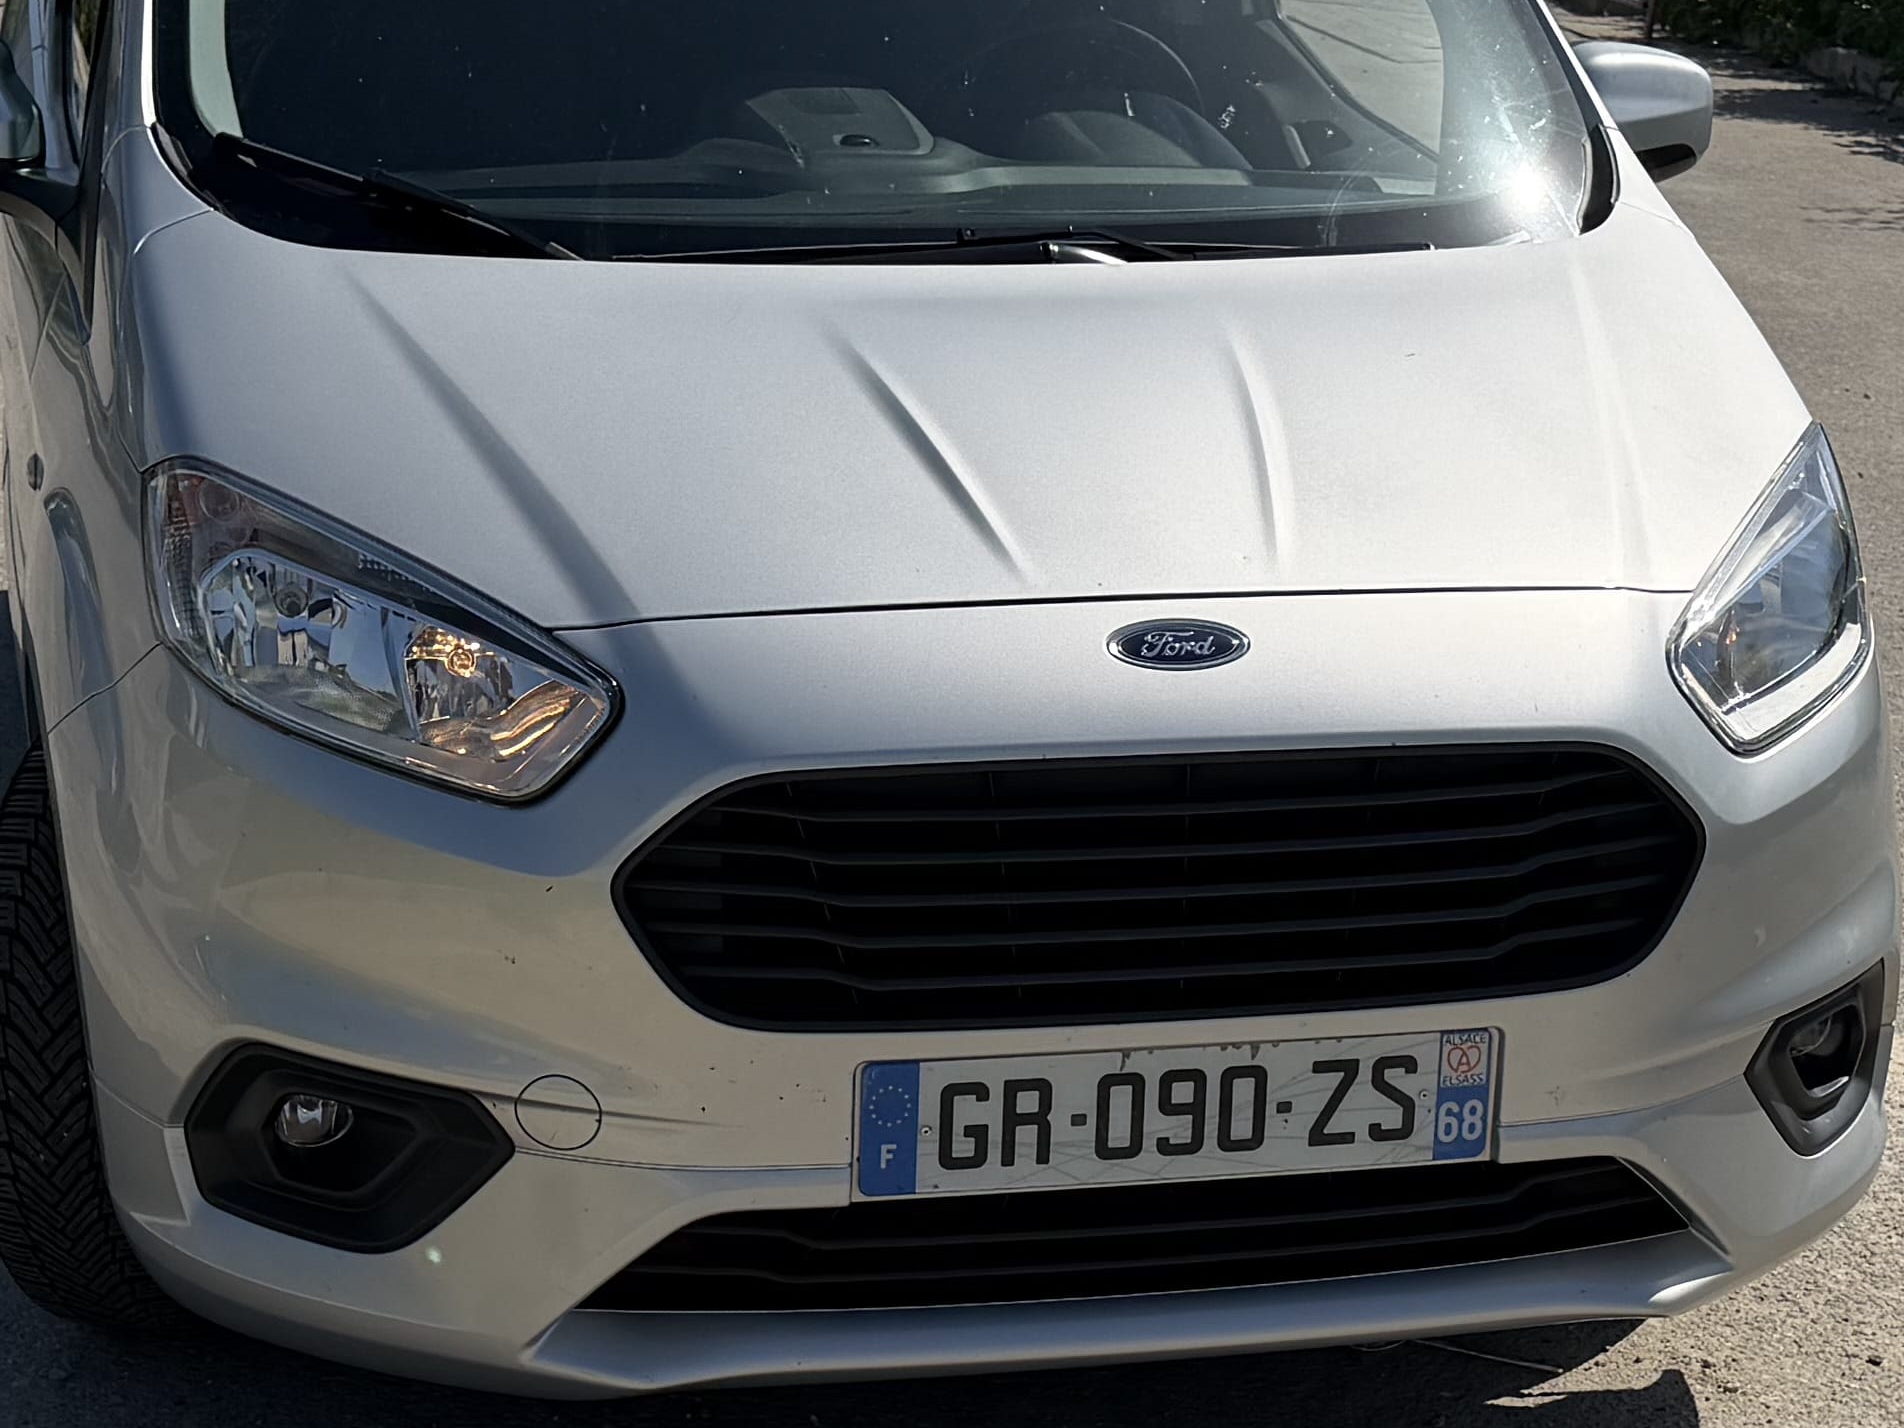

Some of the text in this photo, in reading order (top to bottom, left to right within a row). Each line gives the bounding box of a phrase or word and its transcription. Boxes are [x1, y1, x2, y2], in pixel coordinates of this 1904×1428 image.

[1140, 631, 1216, 658] Ford
[1444, 1033, 1487, 1046] ALSACE
[1442, 1073, 1485, 1086] ELSASS
[937, 1054, 1419, 1171] GR-090-ZS
[1437, 1098, 1485, 1143] 68
[879, 1144, 897, 1170] F
